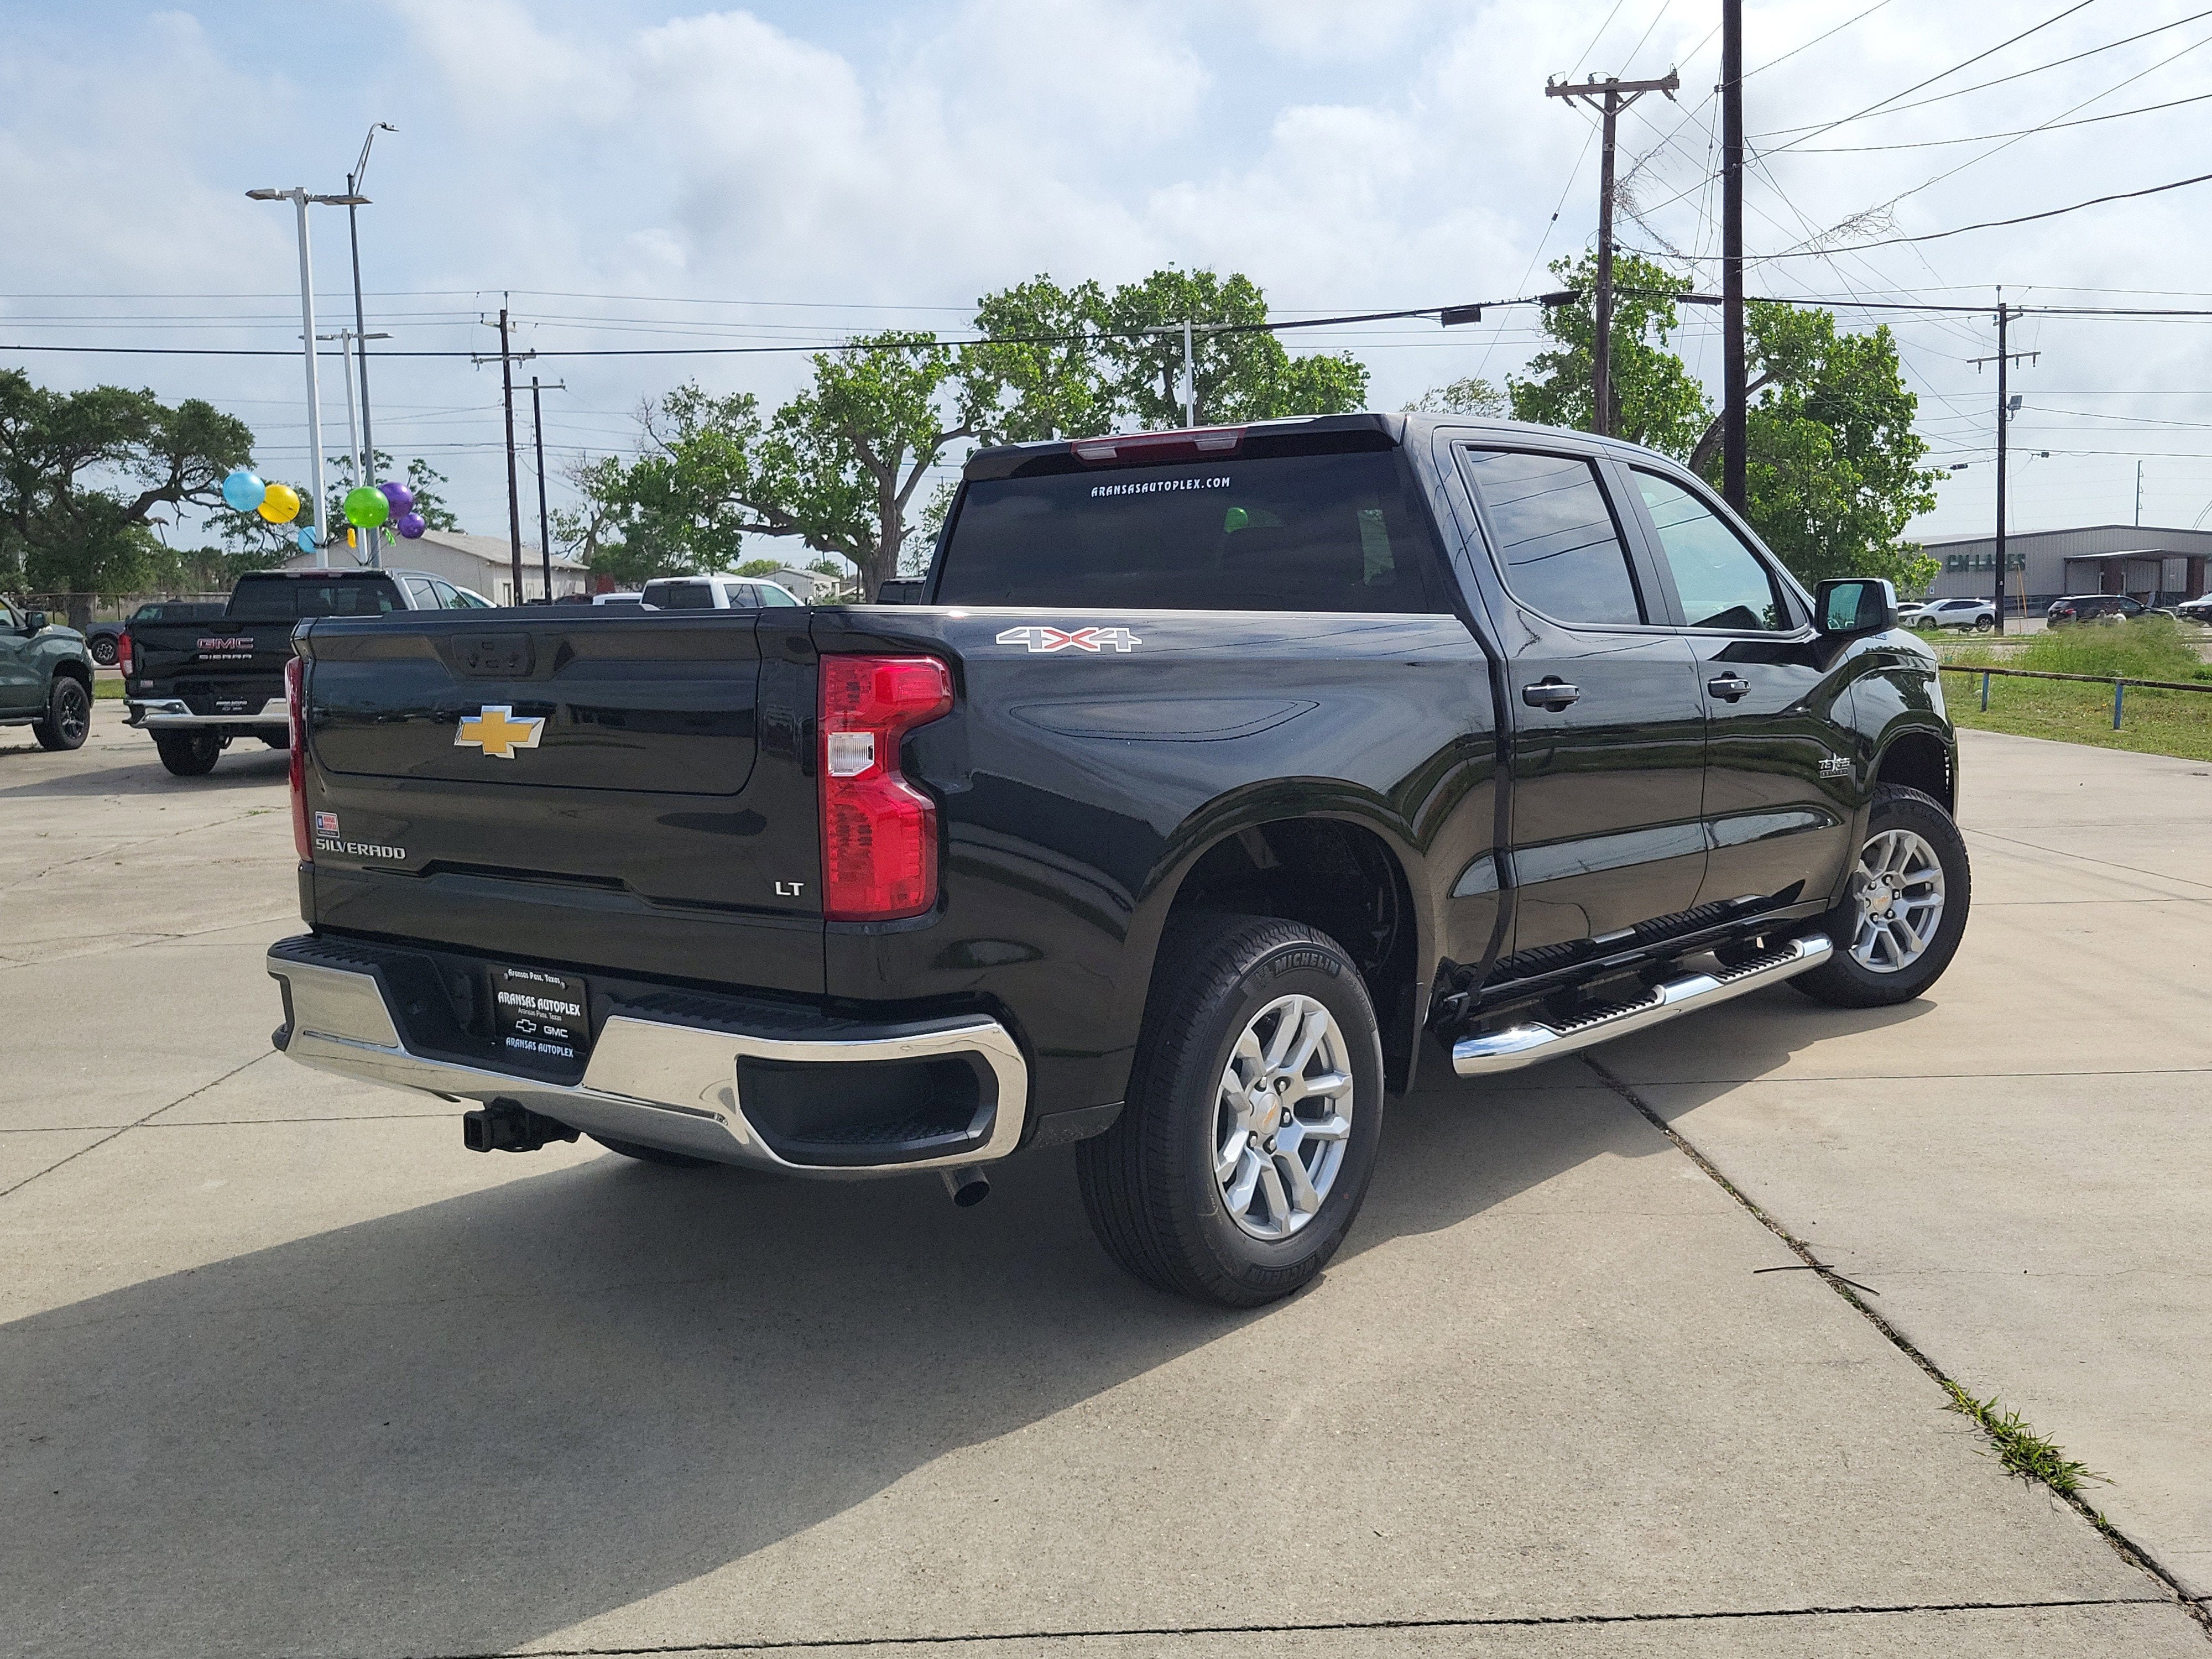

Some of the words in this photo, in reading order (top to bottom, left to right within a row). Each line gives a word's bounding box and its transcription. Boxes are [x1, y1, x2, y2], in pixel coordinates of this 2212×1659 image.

[1091, 477, 1230, 498] ARANSASAUTOPLEX.COM
[197, 638, 254, 649] GMC
[316, 838, 406, 859] SILVERADO
[775, 881, 805, 896] LT
[1275, 952, 1340, 975] MICHELIN
[498, 992, 536, 1009] ARANSAS
[537, 998, 581, 1016] AUTOPLEX
[544, 1025, 568, 1039] GMC
[505, 1037, 536, 1051] ARANSAS
[538, 1043, 574, 1058] AUTOPLEX
